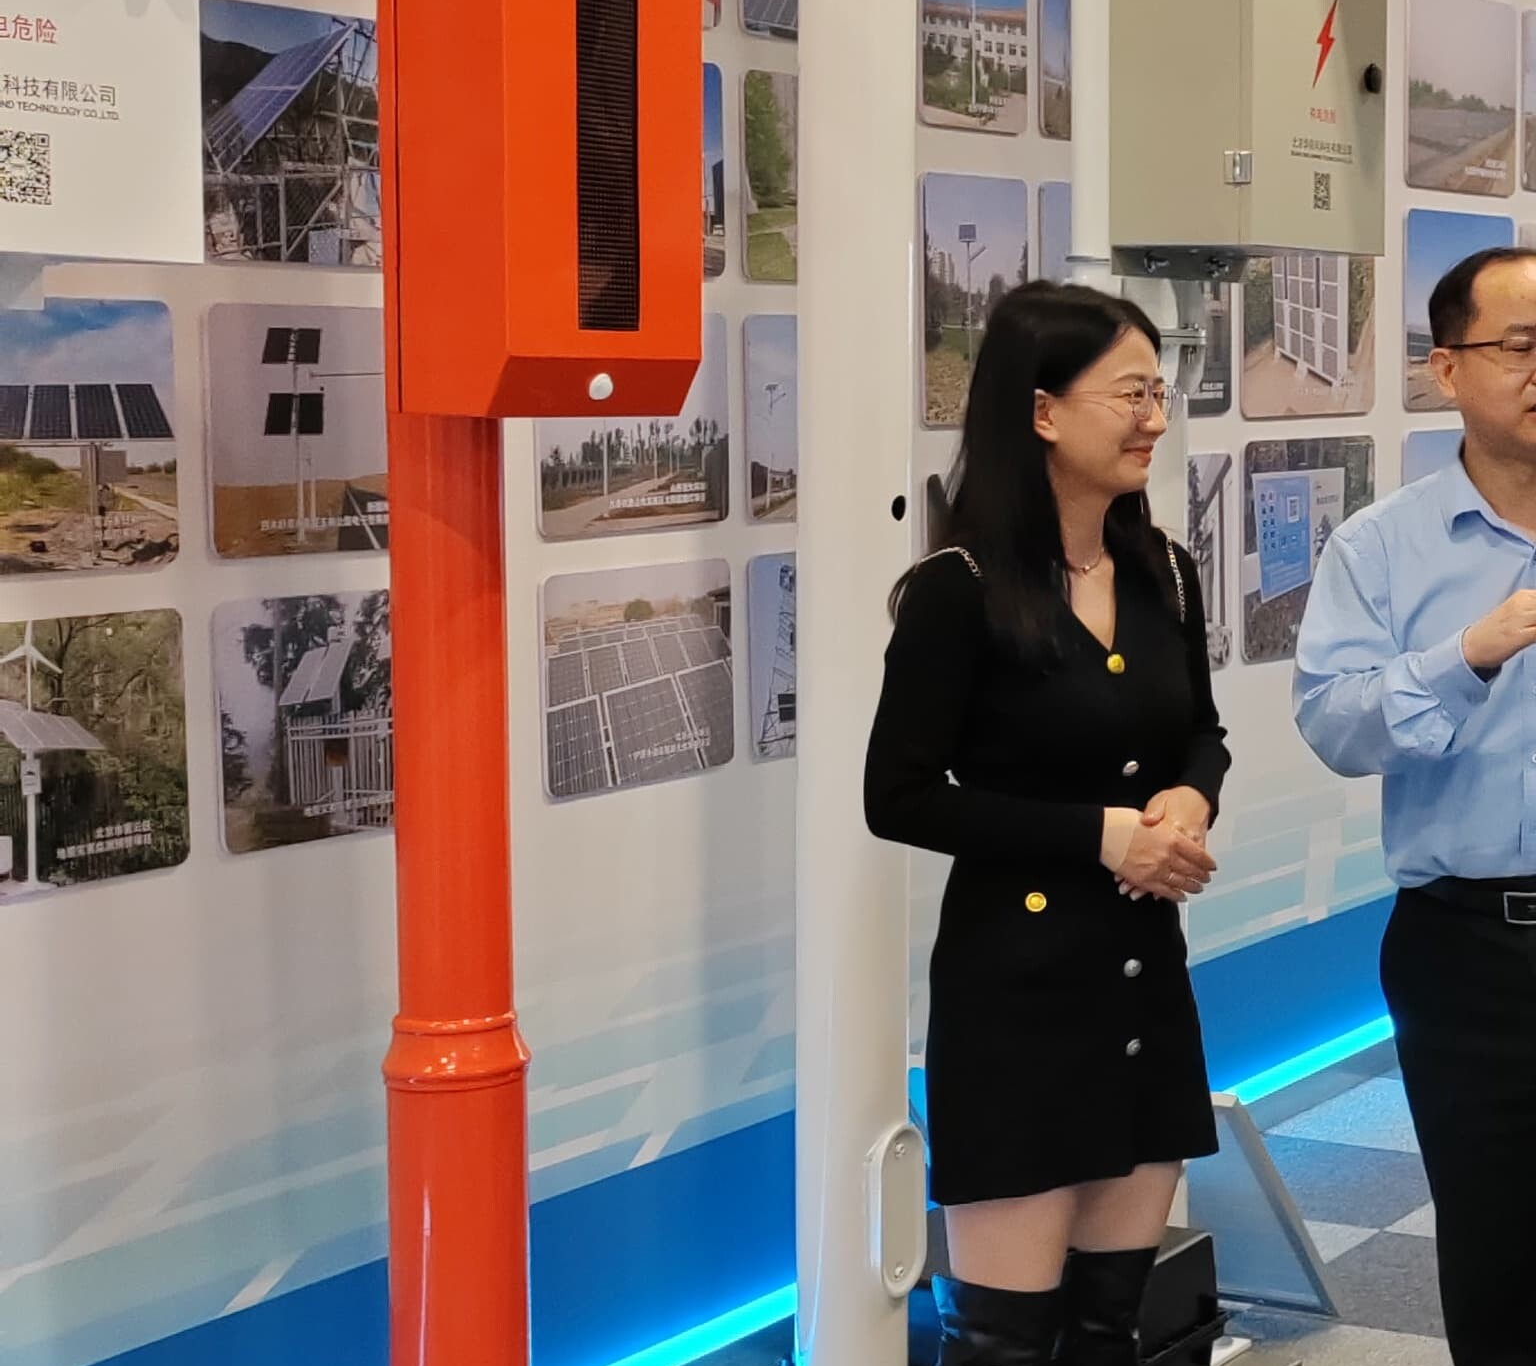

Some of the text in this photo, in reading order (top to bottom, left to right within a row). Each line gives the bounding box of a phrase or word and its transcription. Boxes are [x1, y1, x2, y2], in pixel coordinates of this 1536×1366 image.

[3, 74, 116, 106] 科技有限公司
